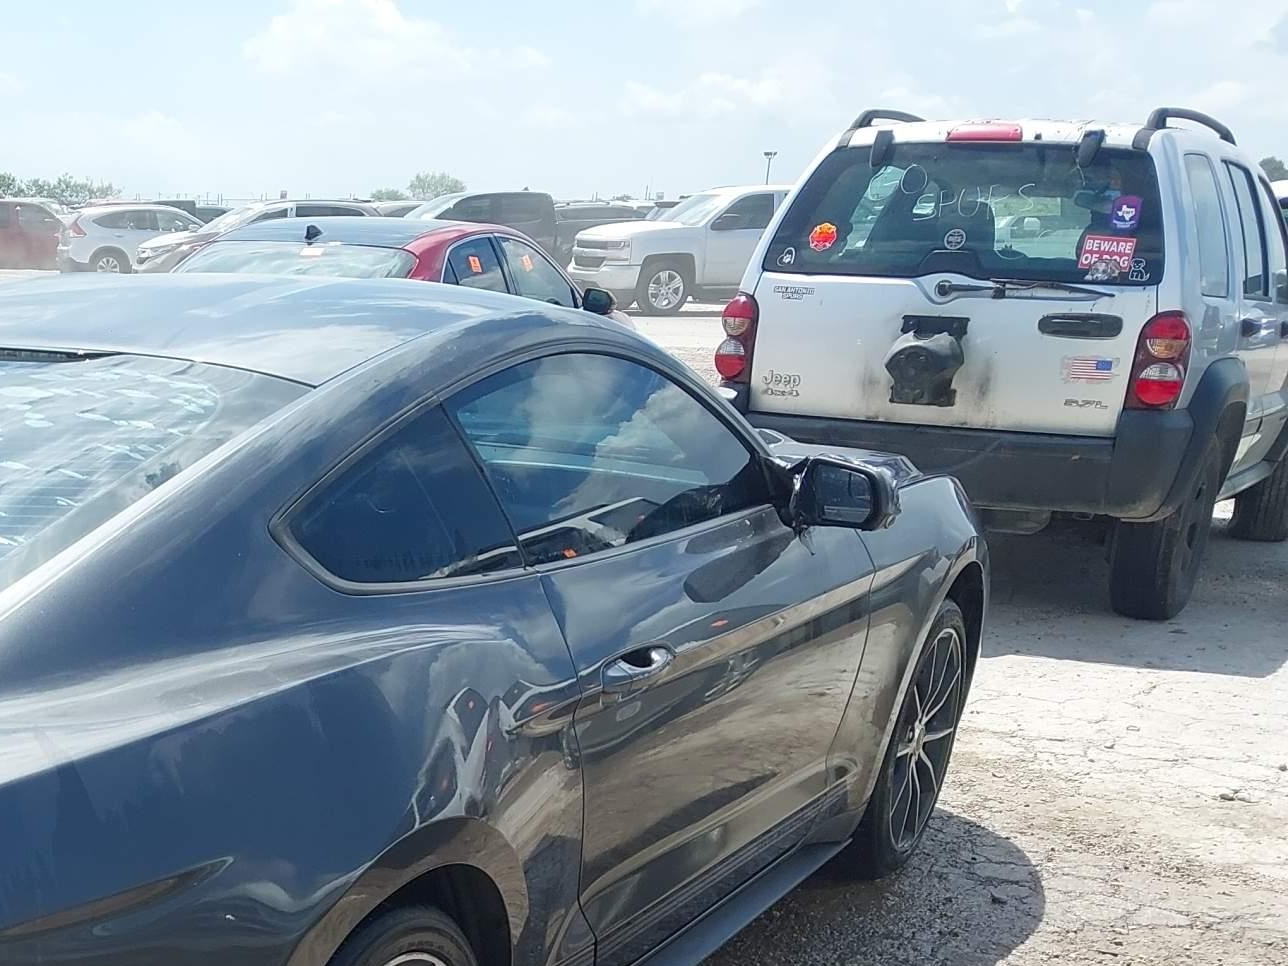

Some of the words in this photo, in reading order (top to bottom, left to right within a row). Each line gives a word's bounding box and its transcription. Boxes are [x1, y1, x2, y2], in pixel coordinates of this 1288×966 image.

[1085, 240, 1133, 253] BEWARE
[1082, 254, 1100, 264] OF
[762, 369, 801, 388] Jeep
